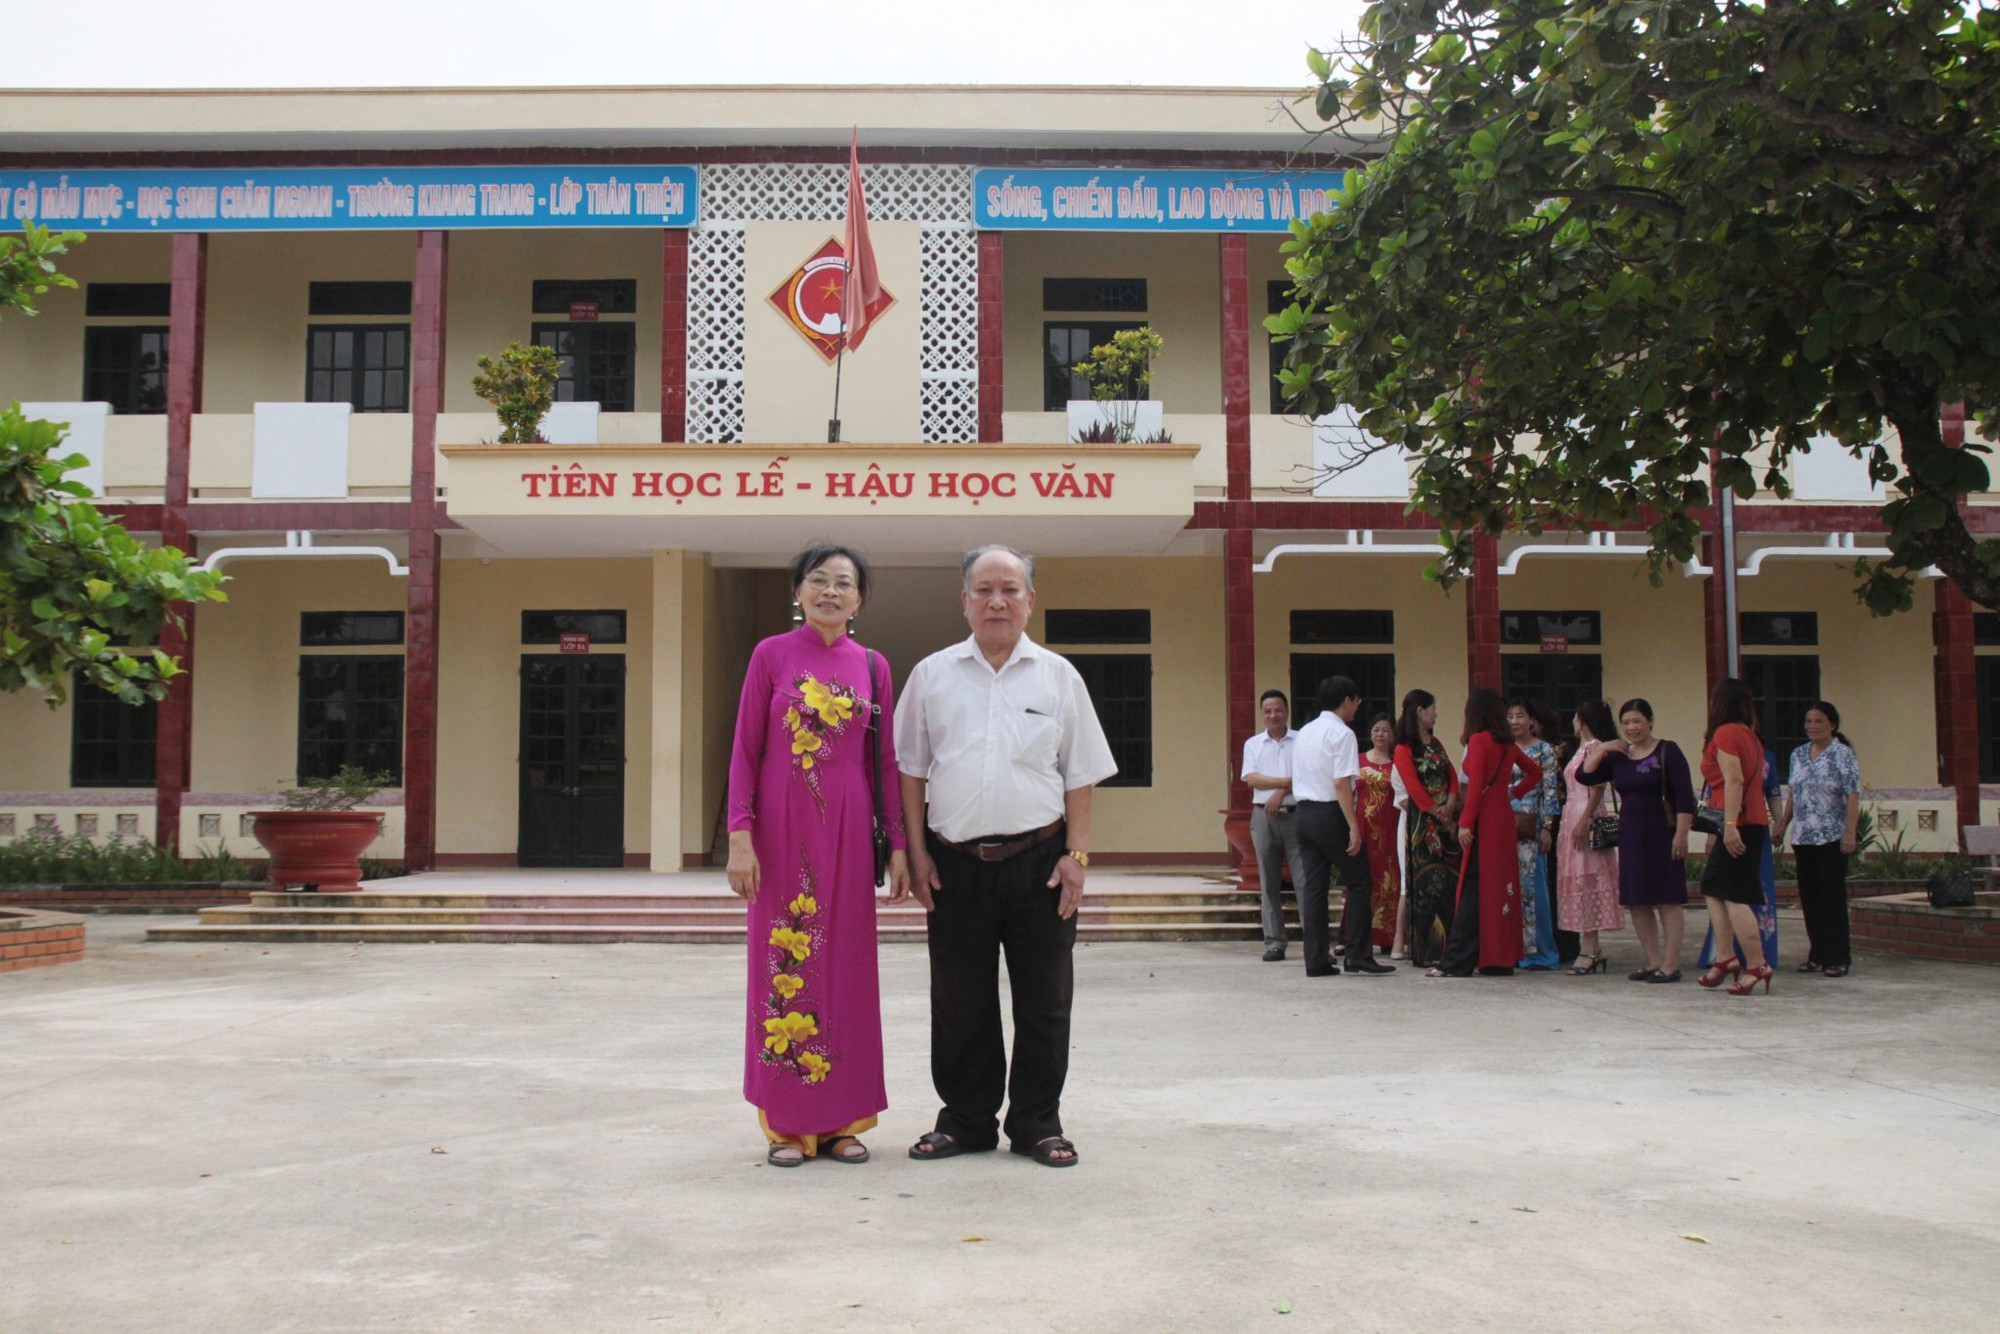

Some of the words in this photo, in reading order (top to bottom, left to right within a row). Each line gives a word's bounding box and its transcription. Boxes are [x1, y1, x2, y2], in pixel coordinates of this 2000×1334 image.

[14, 180, 38, 219] CÔ
[41, 175, 80, 219] MẪU
[137, 187, 172, 226] HỌC
[175, 186, 216, 218] SINH
[221, 179, 270, 218] CHĂM
[274, 185, 333, 218] NGOAN
[348, 177, 415, 217] TRƯỜNG
[417, 184, 476, 216] KHANG
[480, 184, 534, 216] TRANG
[549, 176, 582, 215] LỚP
[586, 176, 631, 215] THÂN
[634, 176, 684, 222] THIỆN
[987, 174, 1047, 222] SỐNG,
[1053, 176, 1113, 218] CHIẾN
[1117, 175, 1164, 223] ĐẤU,
[1168, 187, 1205, 219] LAO
[1209, 182, 1264, 226] ĐỘNG
[1268, 181, 1295, 220] VÀ
[632, 472, 721, 505] HỌC
[736, 456, 790, 497] LỄ
[825, 462, 915, 505] HẬU
[928, 472, 1017, 506] HỌC
[1030, 463, 1115, 498] VĂN
